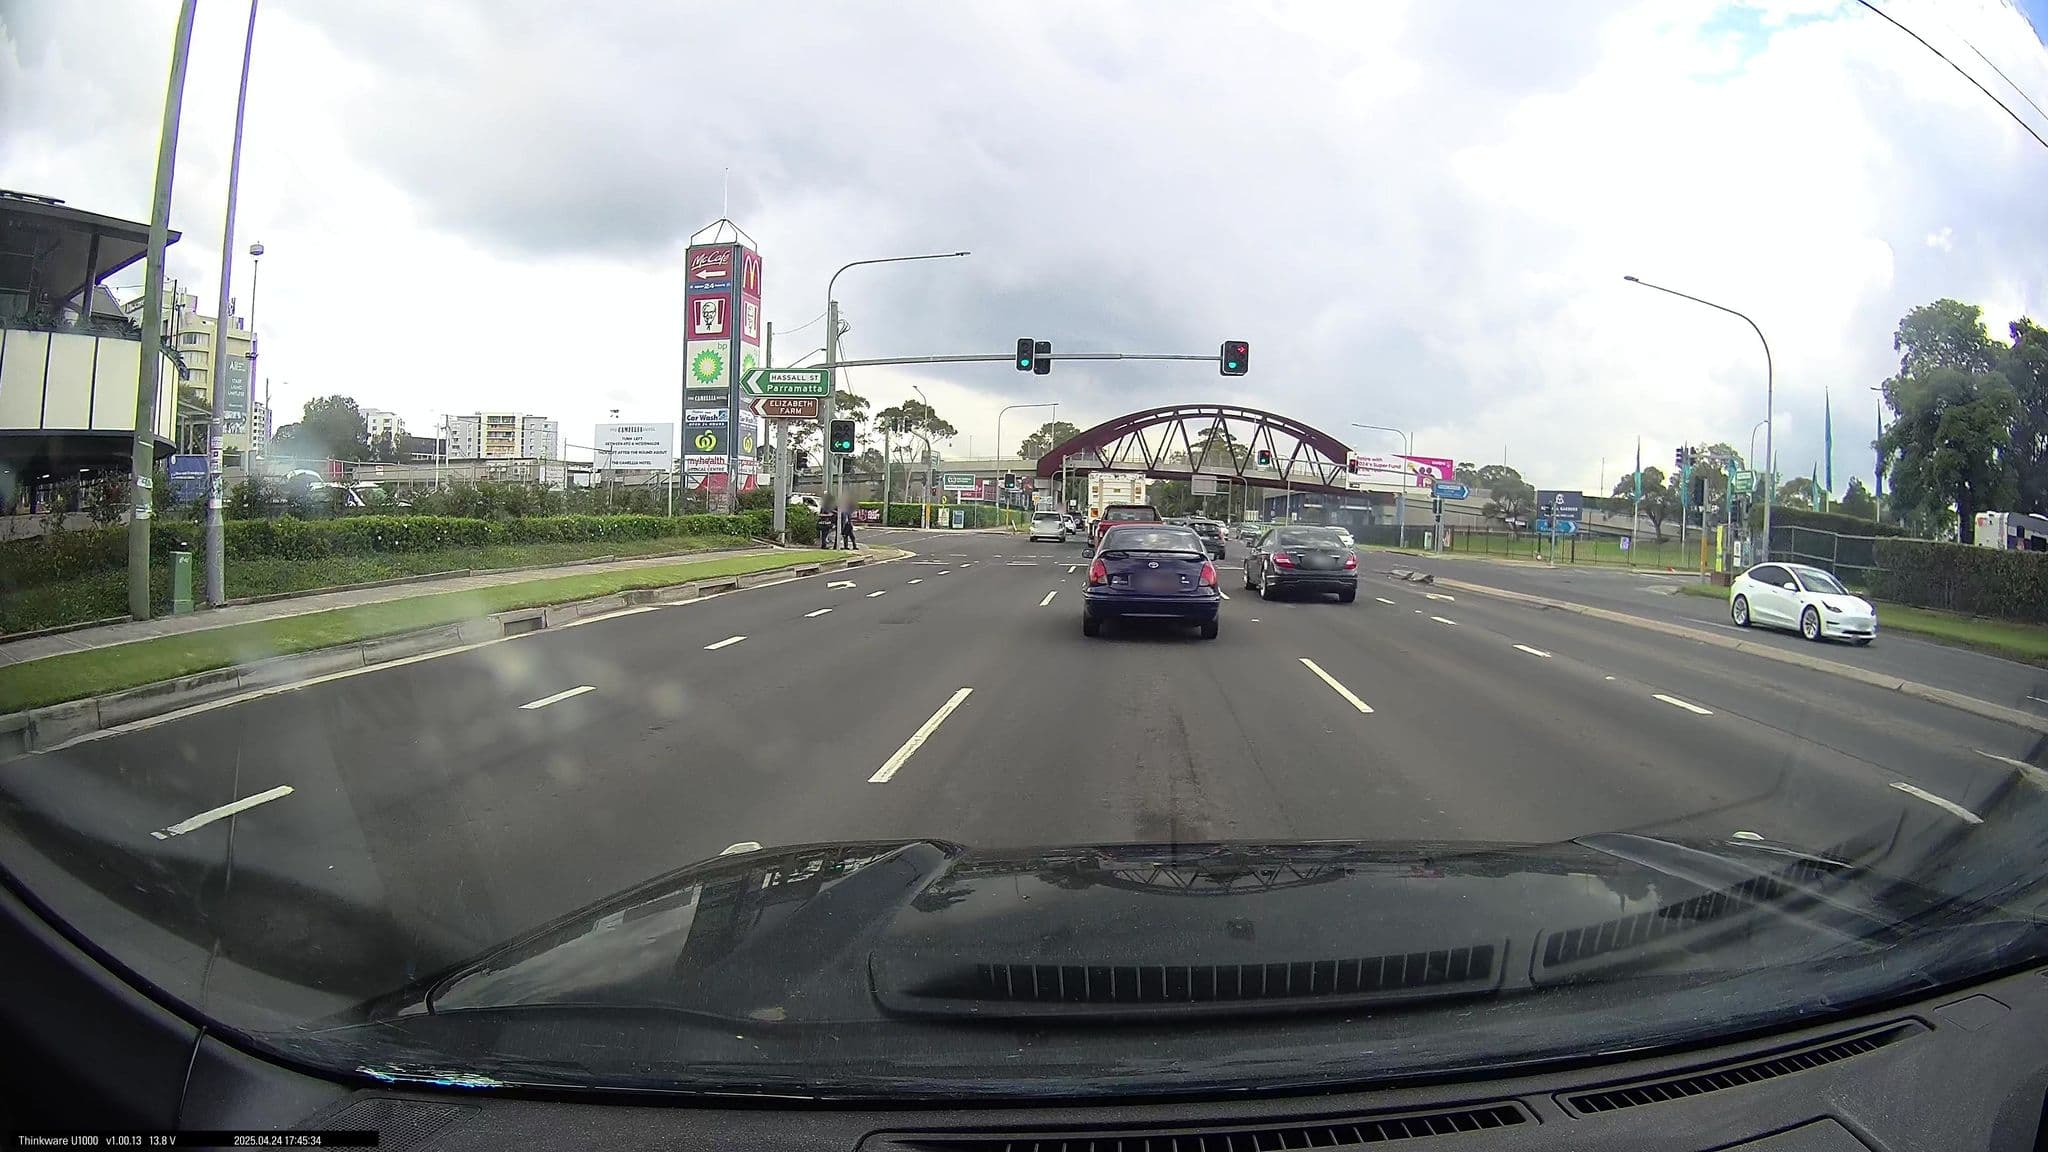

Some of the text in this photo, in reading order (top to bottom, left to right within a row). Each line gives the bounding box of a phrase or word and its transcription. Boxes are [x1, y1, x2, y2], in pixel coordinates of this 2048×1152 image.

[717, 342, 728, 350] bp
[767, 384, 823, 393] Parramatta
[687, 455, 725, 466] myhealth
